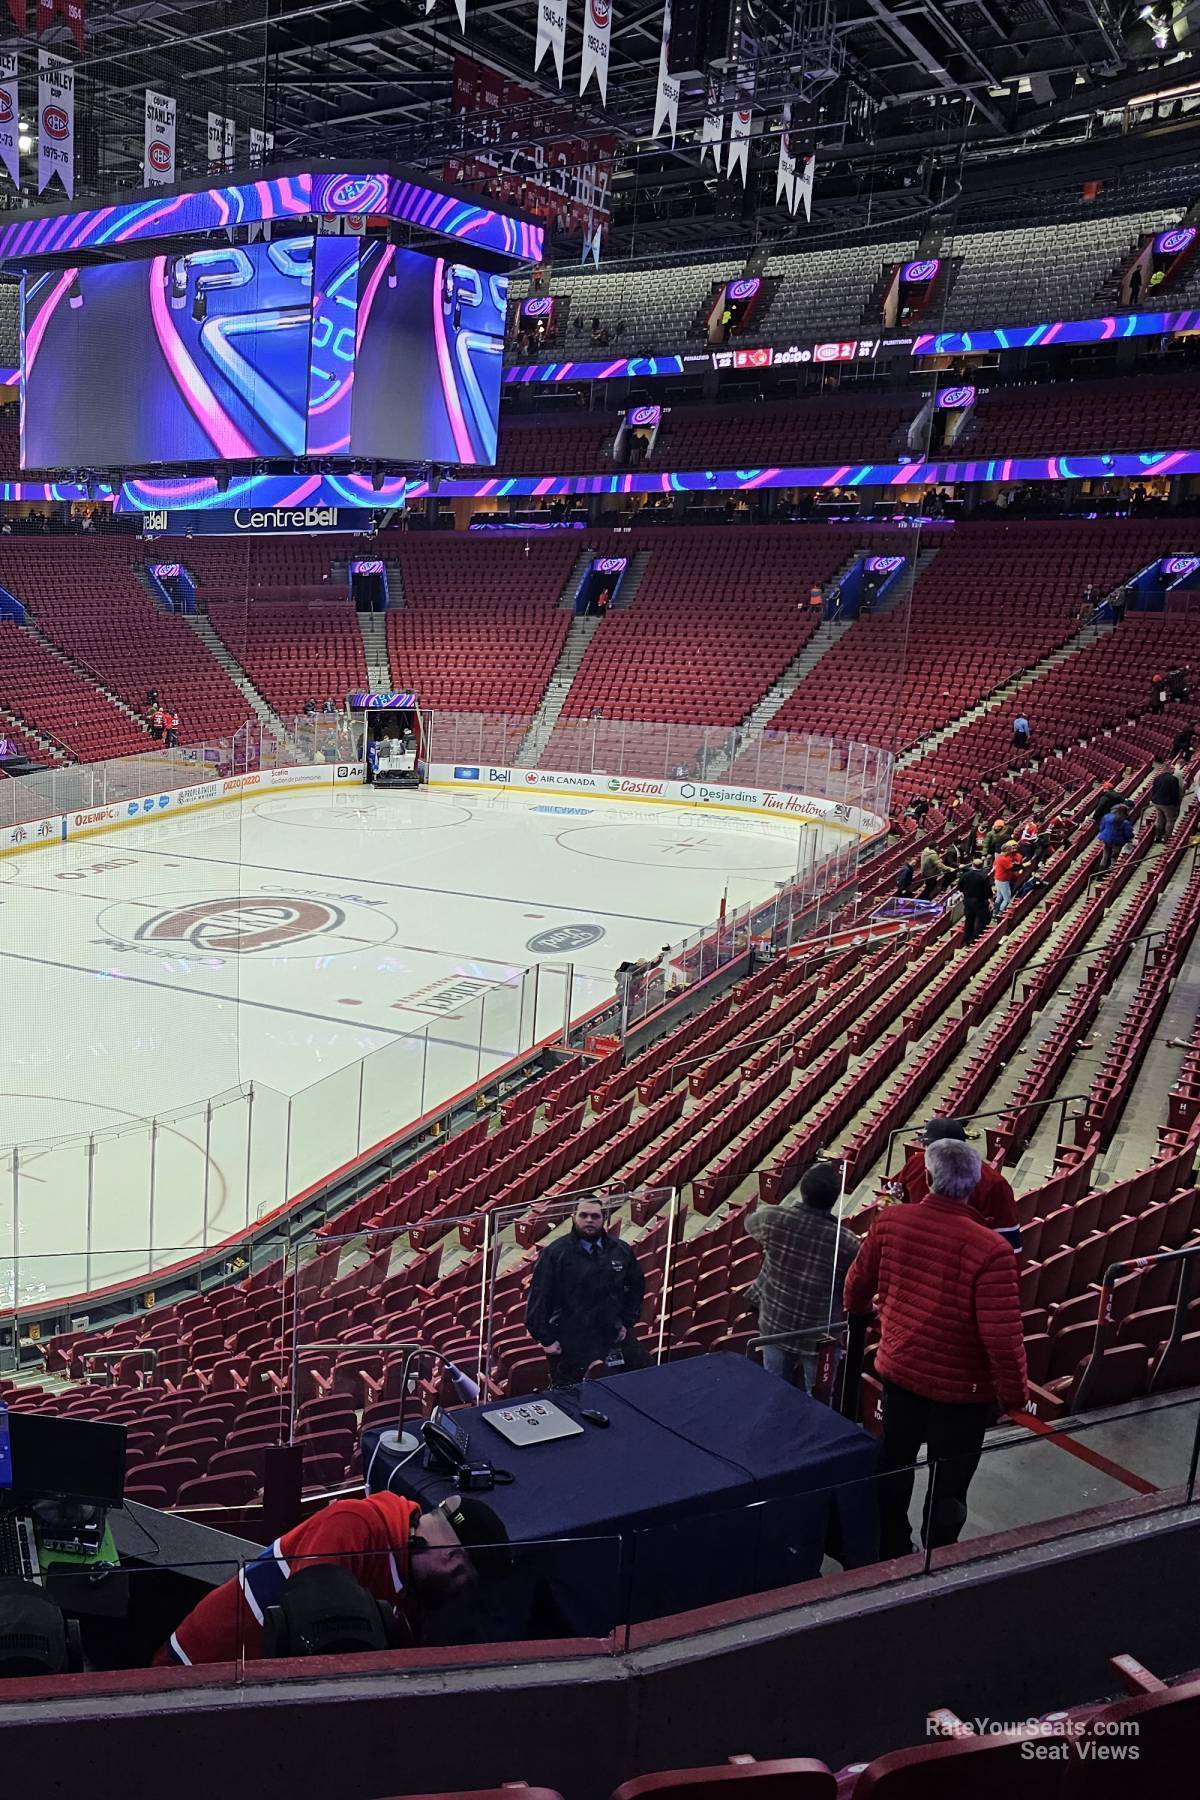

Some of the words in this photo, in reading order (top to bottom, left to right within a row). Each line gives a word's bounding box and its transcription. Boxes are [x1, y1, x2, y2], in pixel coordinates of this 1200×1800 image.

[147, 106, 175, 127] STANLEY
[43, 146, 69, 163] 1975-76
[774, 351, 811, 364] 20:00
[842, 346, 850, 356] 2
[738, 354, 746, 364] 5
[234, 508, 338, 528] CentreBell
[271, 769, 288, 777] Scotia
[489, 769, 511, 782] Bell
[540, 775, 555, 783] AIR
[556, 776, 596, 786] CANADA
[621, 780, 663, 795] Castrol
[700, 787, 757, 804] Desjardins
[762, 792, 784, 809] Tim
[785, 795, 827, 818] Hortons
[537, 928, 595, 949] Ford
[1179, 1102, 1187, 1112] H
[876, 1399, 883, 1412] L
[1024, 1400, 1037, 1415] M
